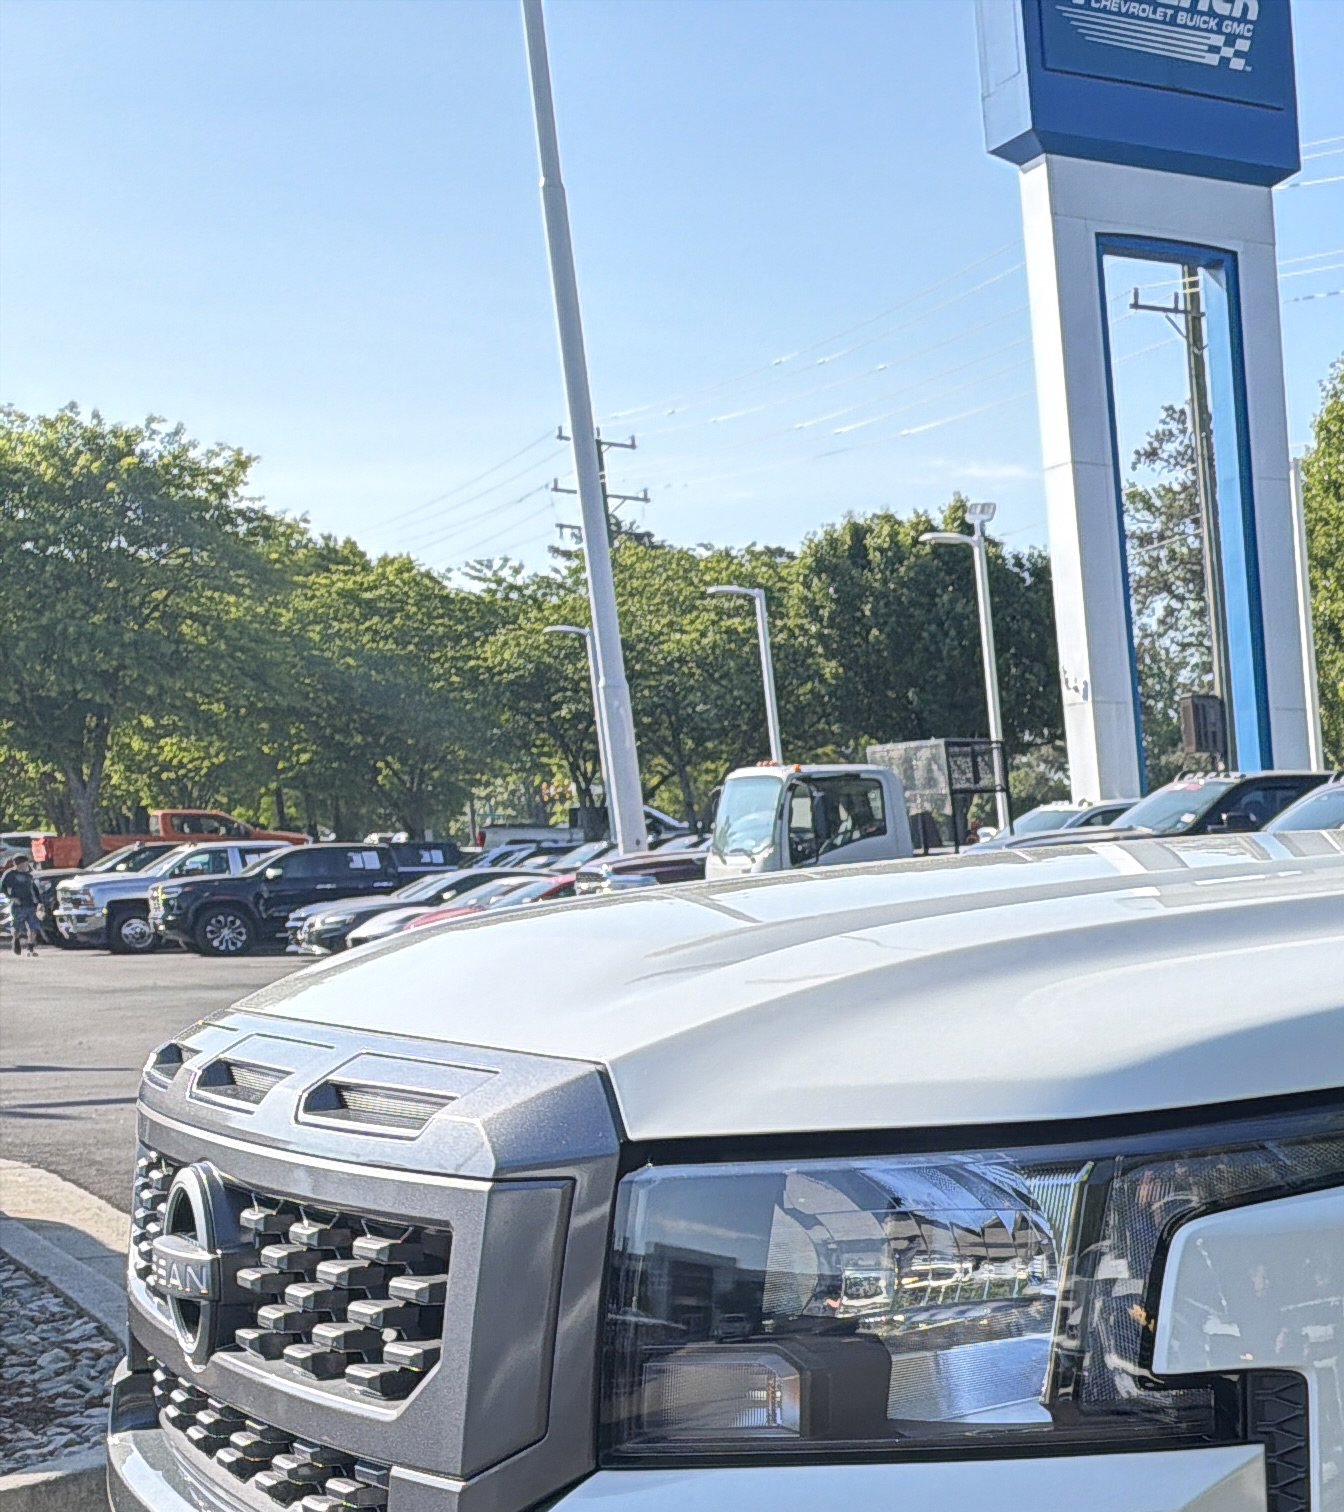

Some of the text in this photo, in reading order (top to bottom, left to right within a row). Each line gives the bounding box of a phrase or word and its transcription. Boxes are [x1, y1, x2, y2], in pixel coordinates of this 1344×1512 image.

[1090, 0, 1174, 22] CHEVROLET
[1176, 11, 1220, 30] BUICK
[1221, 21, 1254, 37] GMC
